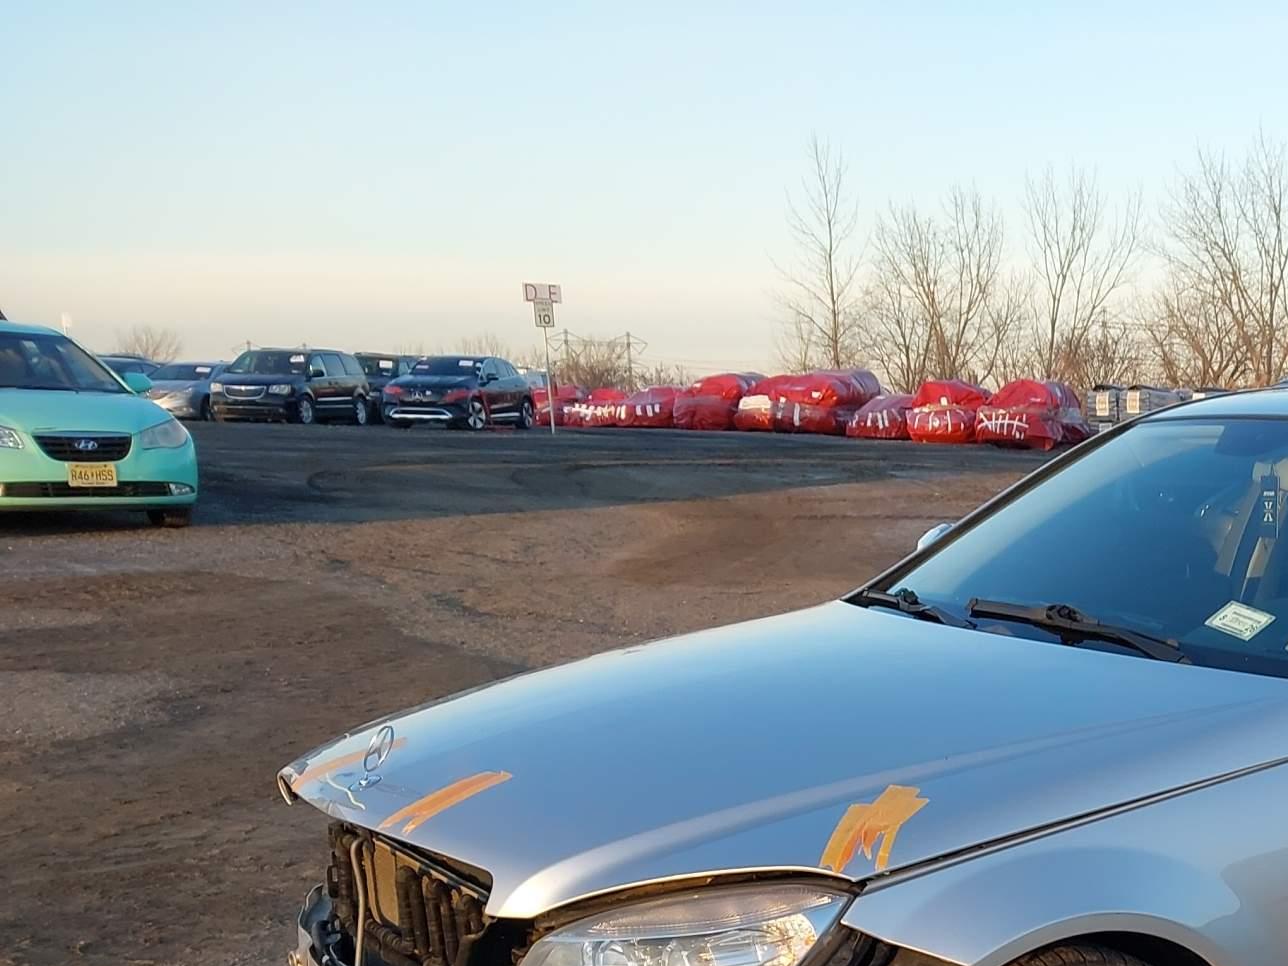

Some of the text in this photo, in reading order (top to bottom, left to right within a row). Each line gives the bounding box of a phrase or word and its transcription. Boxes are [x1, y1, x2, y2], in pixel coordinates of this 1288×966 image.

[524, 283, 559, 303] D E
[538, 313, 551, 325] 10
